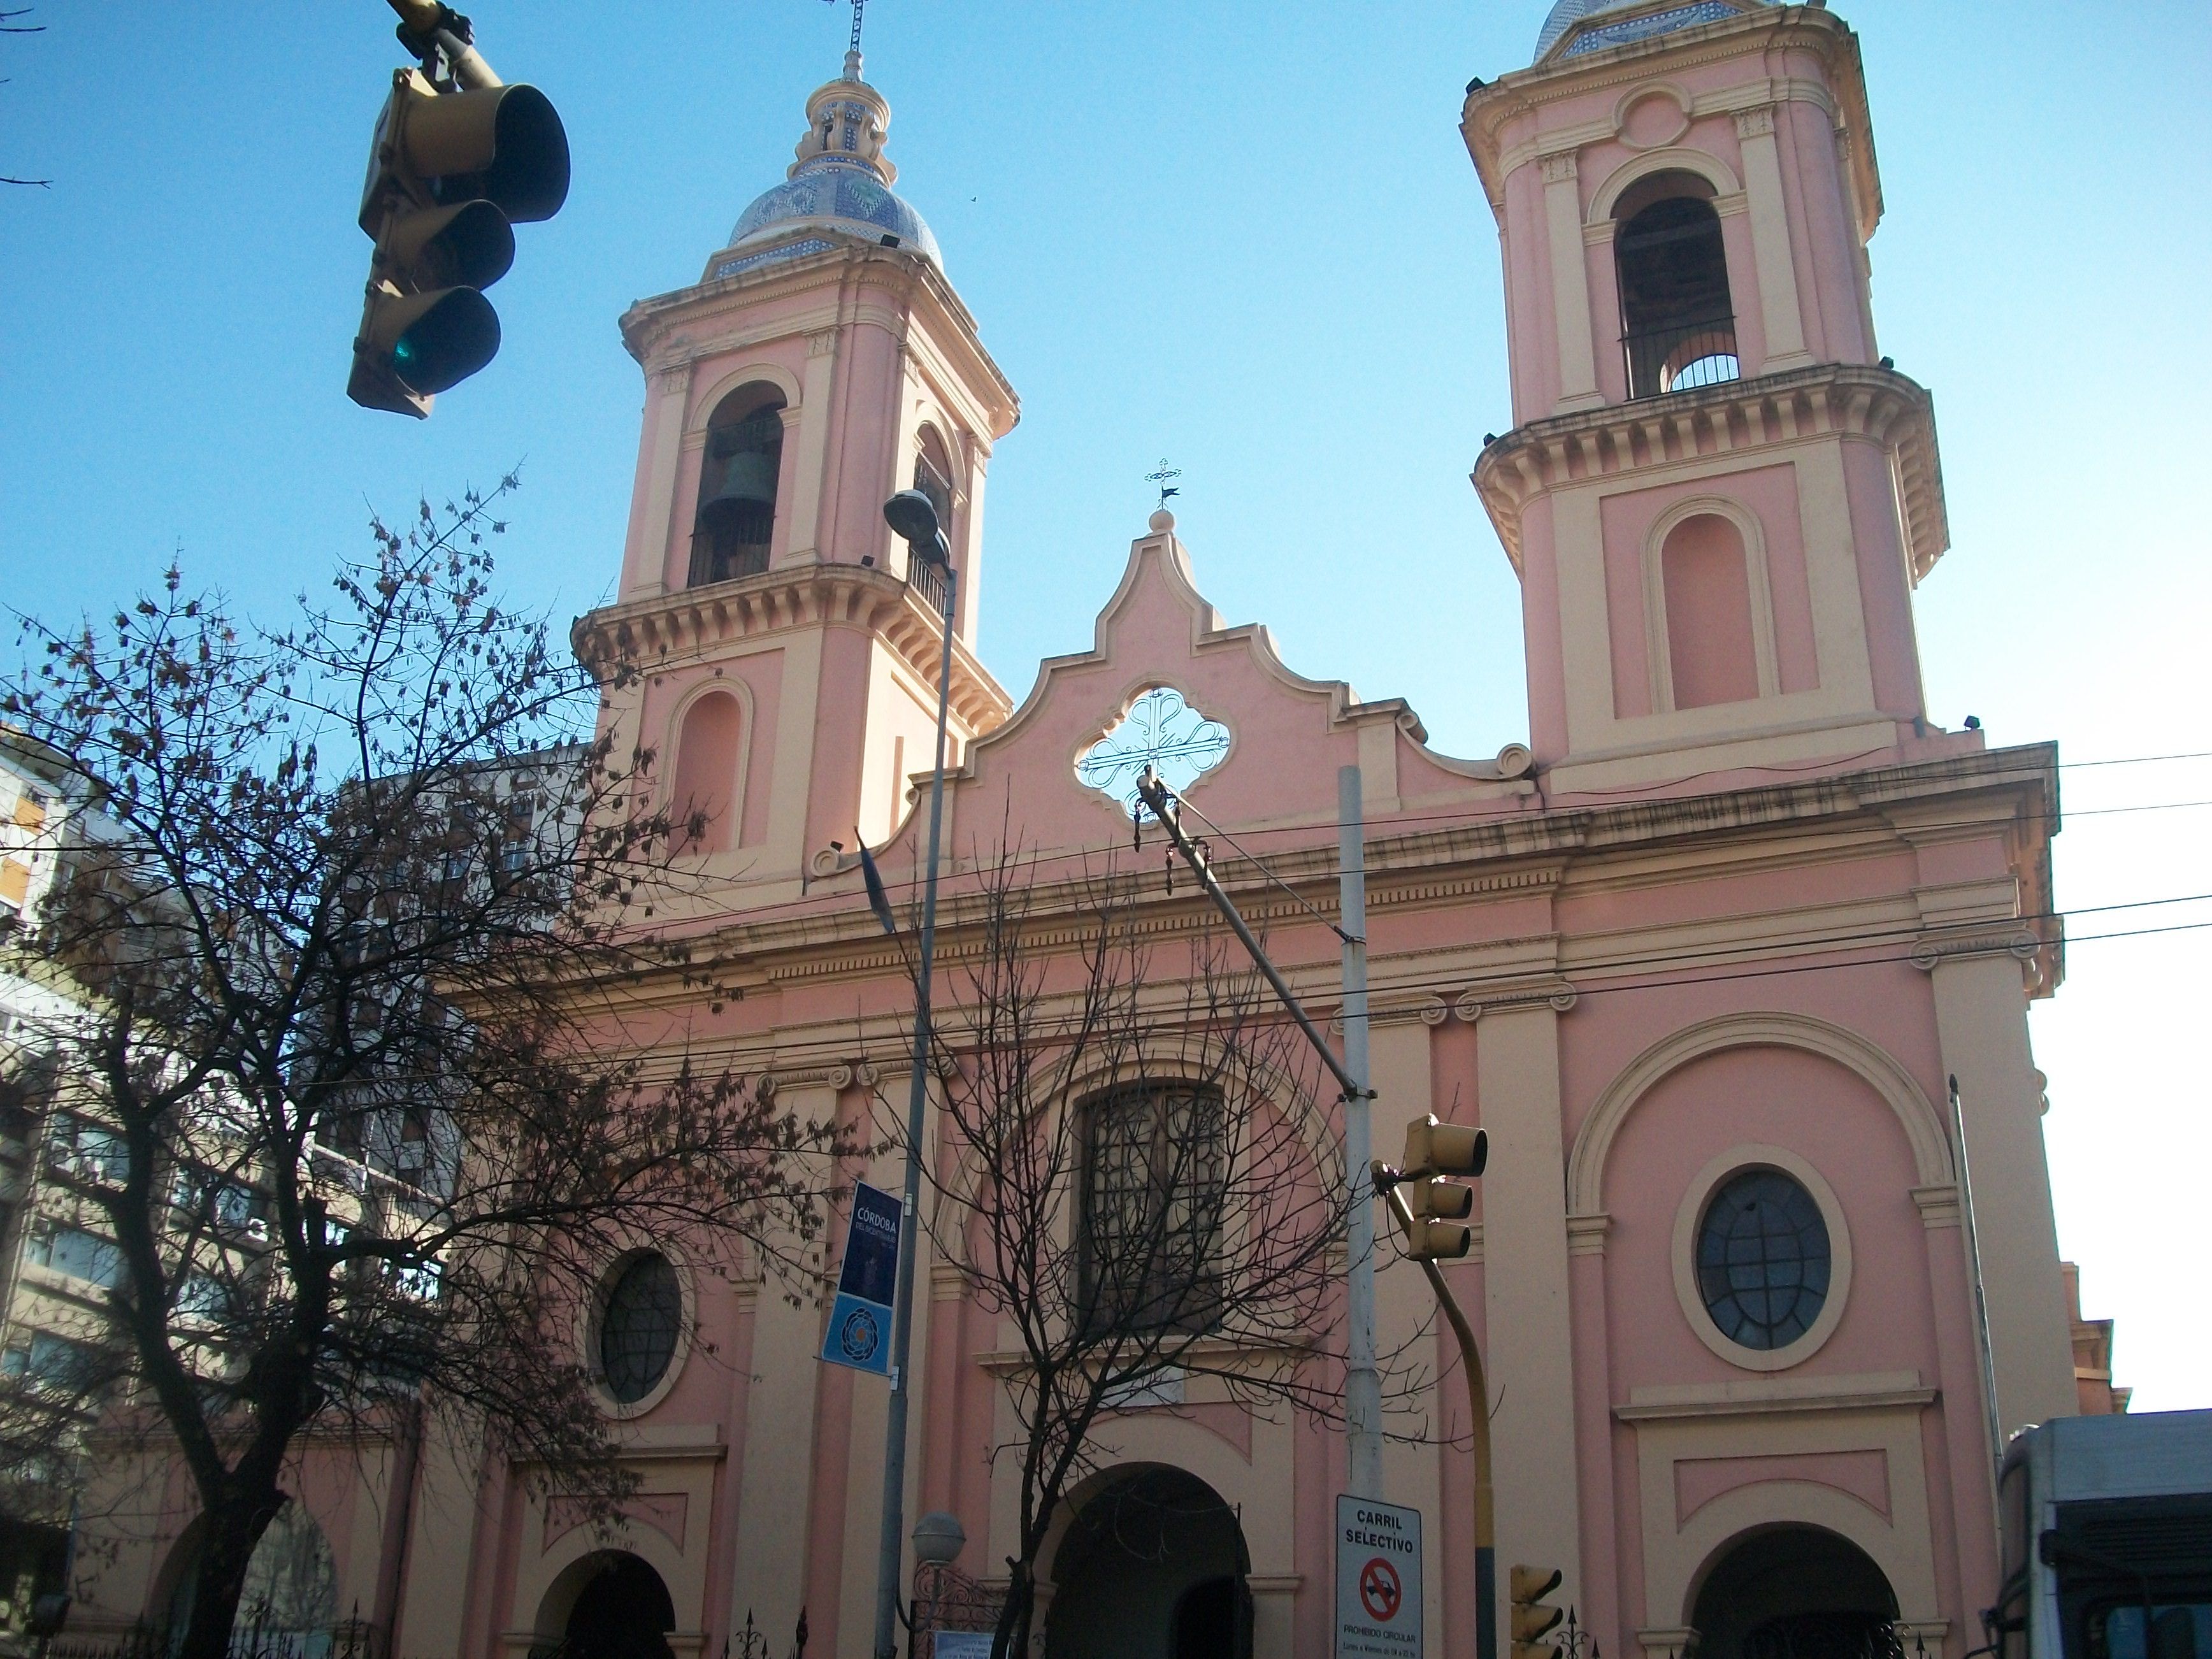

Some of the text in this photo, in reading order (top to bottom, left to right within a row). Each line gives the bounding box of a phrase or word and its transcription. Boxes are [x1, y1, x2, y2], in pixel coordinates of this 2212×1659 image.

[858, 1207, 896, 1233] CÓRDOBA
[1357, 1510, 1402, 1529] CARRIL
[1346, 1530, 1412, 1553] SELECTIVO
[1344, 1625, 1416, 1643] PROHIBIDO CIRCULAR
